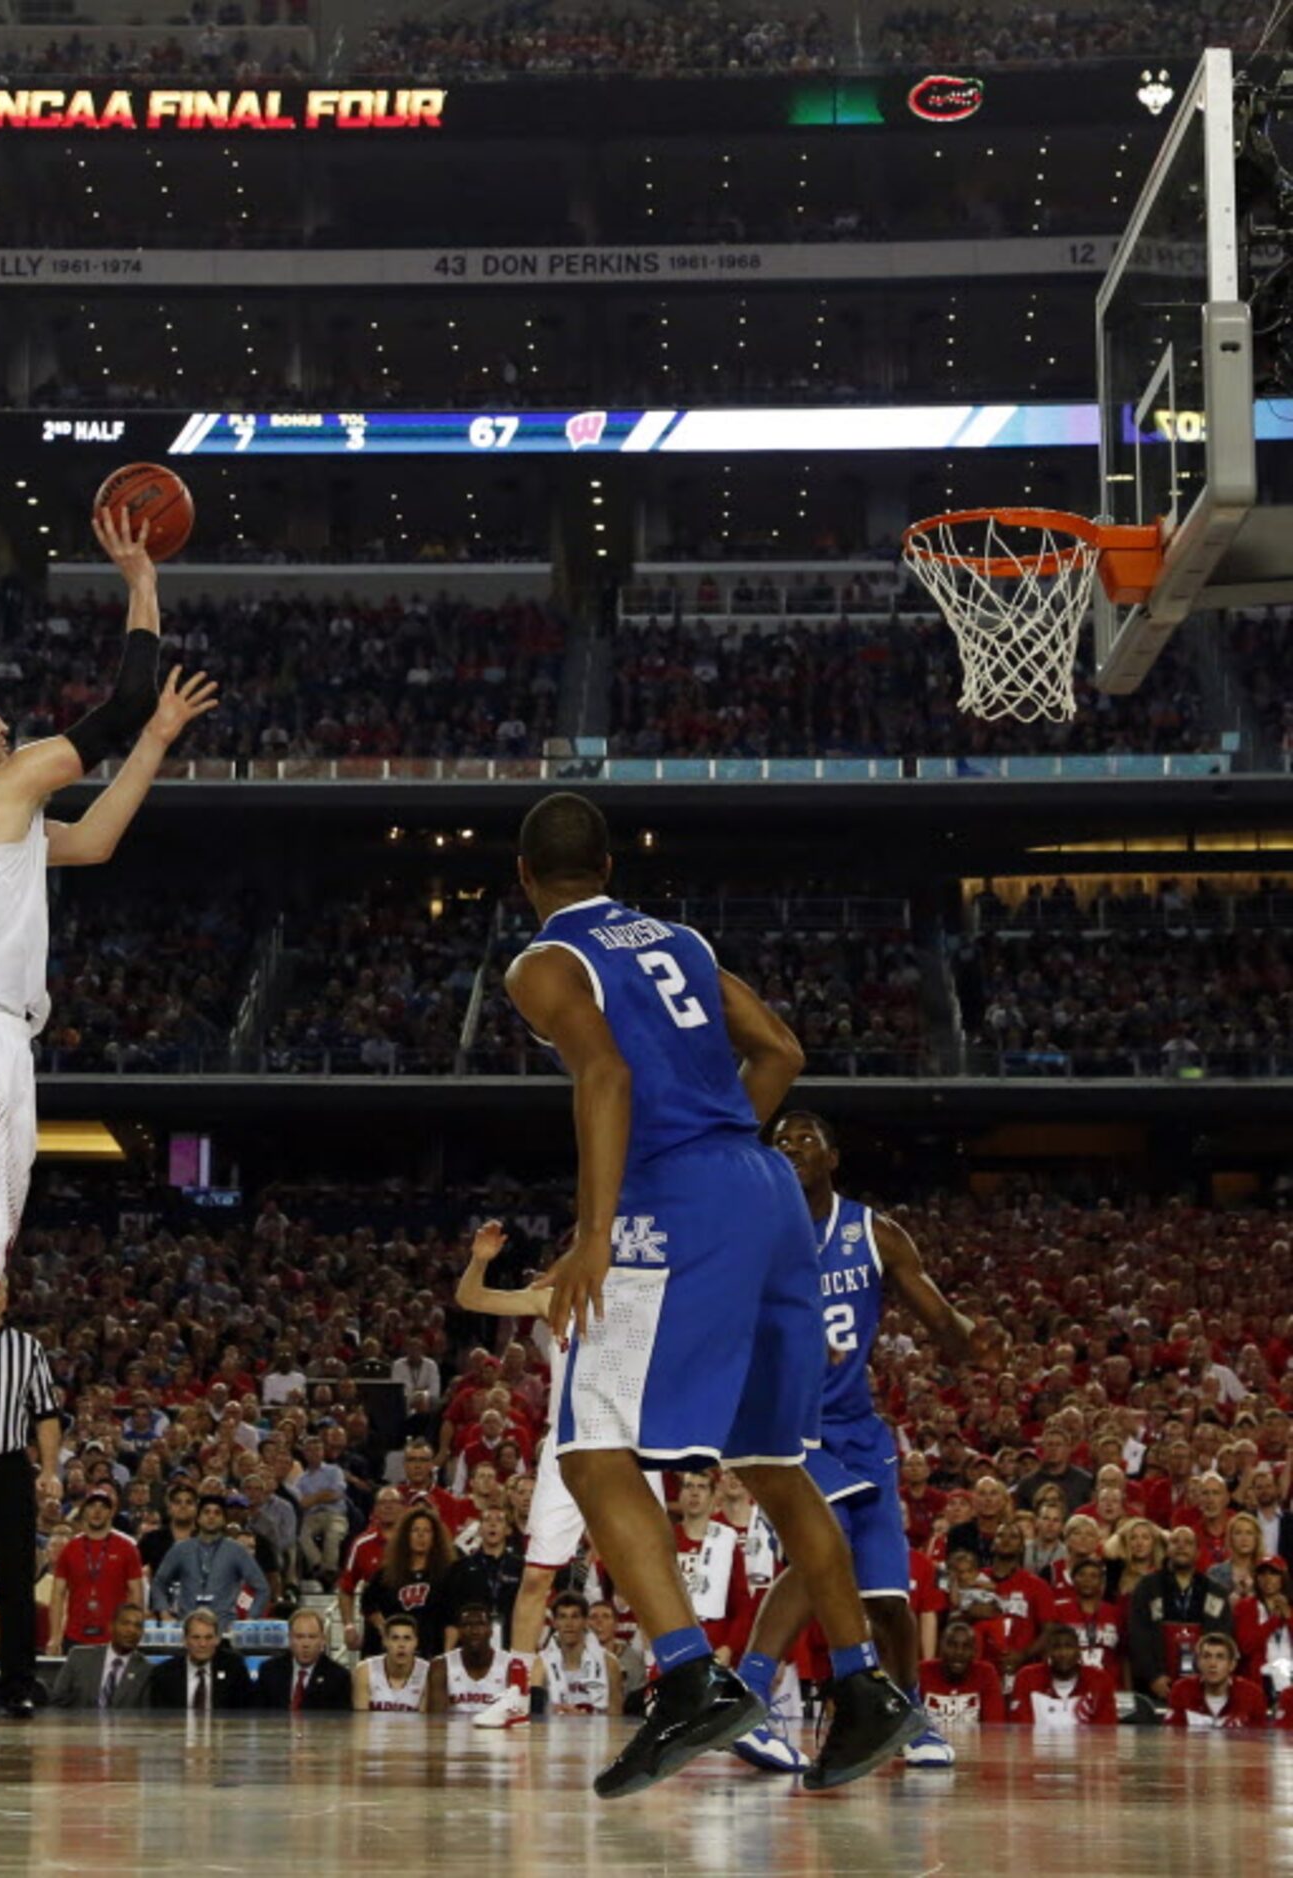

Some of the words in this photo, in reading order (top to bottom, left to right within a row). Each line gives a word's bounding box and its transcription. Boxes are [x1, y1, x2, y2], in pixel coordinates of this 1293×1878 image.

[148, 89, 296, 129] FINAL
[305, 89, 445, 129] FOUR
[434, 255, 467, 276] 43
[482, 255, 537, 276] DON
[549, 253, 660, 275] PERKINS
[1069, 243, 1096, 264] 12
[51, 259, 142, 274] 1961-1974
[75, 420, 125, 441] HALF
[270, 414, 322, 426] BONUS
[235, 426, 254, 451] 7
[346, 426, 365, 450] 3
[469, 416, 519, 448] 67
[636, 950, 709, 1028] 2
